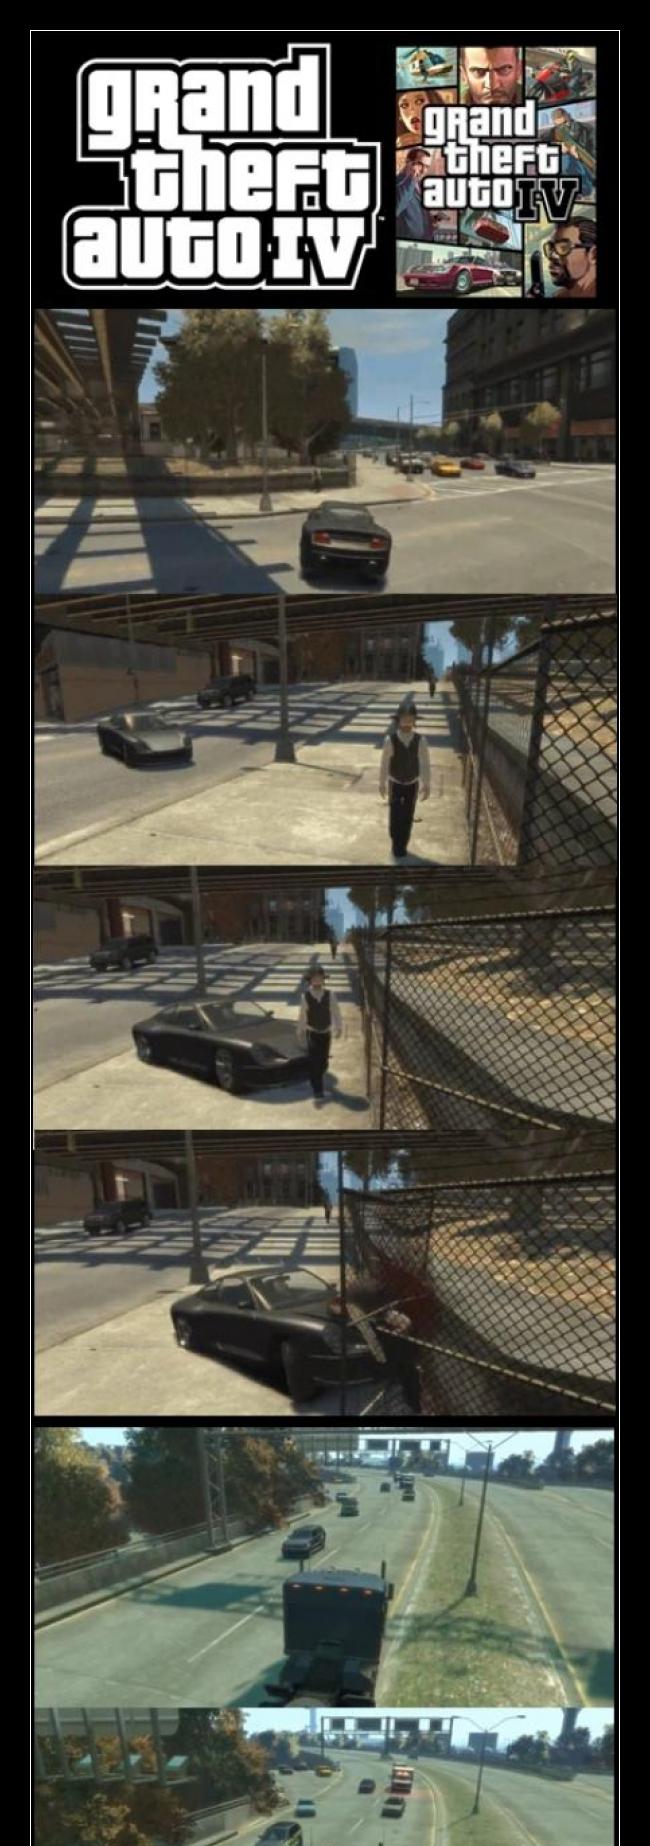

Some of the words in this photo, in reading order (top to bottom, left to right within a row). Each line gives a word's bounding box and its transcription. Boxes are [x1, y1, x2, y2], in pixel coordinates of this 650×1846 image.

[87, 54, 321, 151] grand
[423, 100, 536, 146] grand
[130, 140, 370, 212] theft
[445, 142, 560, 175] theft
[422, 178, 514, 209] auto
[515, 178, 580, 221] IV
[73, 216, 261, 279] auto
[272, 216, 365, 279] IV
